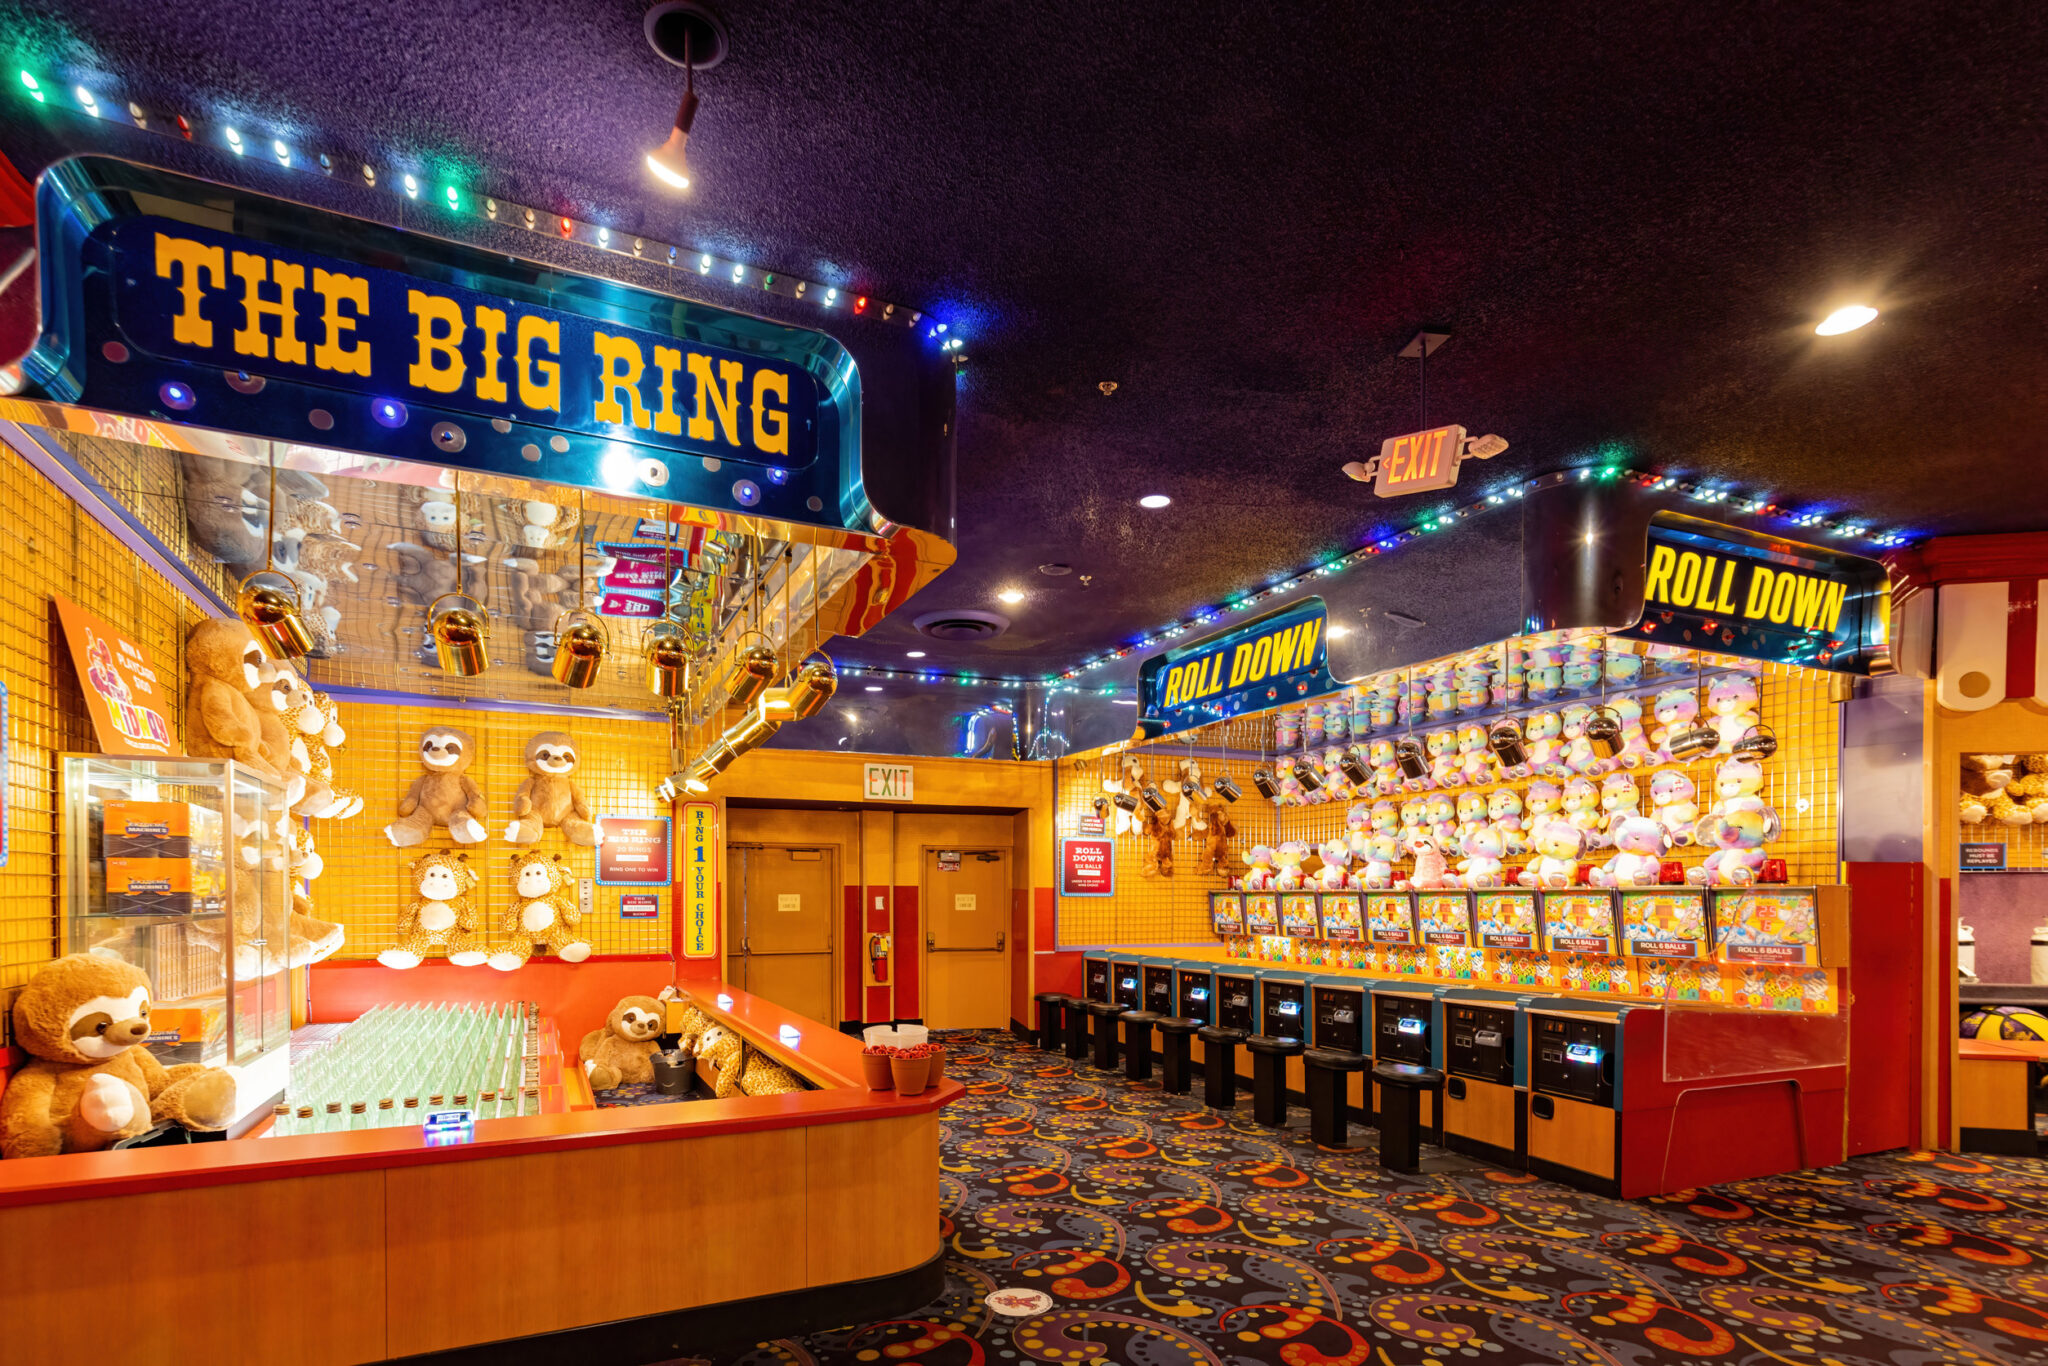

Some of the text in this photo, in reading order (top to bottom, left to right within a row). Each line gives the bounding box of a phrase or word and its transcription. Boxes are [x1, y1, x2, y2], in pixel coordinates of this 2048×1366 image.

[155, 232, 789, 456] THE BIG RING
[1388, 429, 1449, 485] EXIT
[1645, 544, 1848, 633] ROLL DOWN
[1163, 617, 1322, 707] ROLL DOWN
[869, 768, 909, 797] EXIT
[694, 811, 706, 951] RING 1 YOUR CHOICE
[1758, 906, 1777, 918] 25
